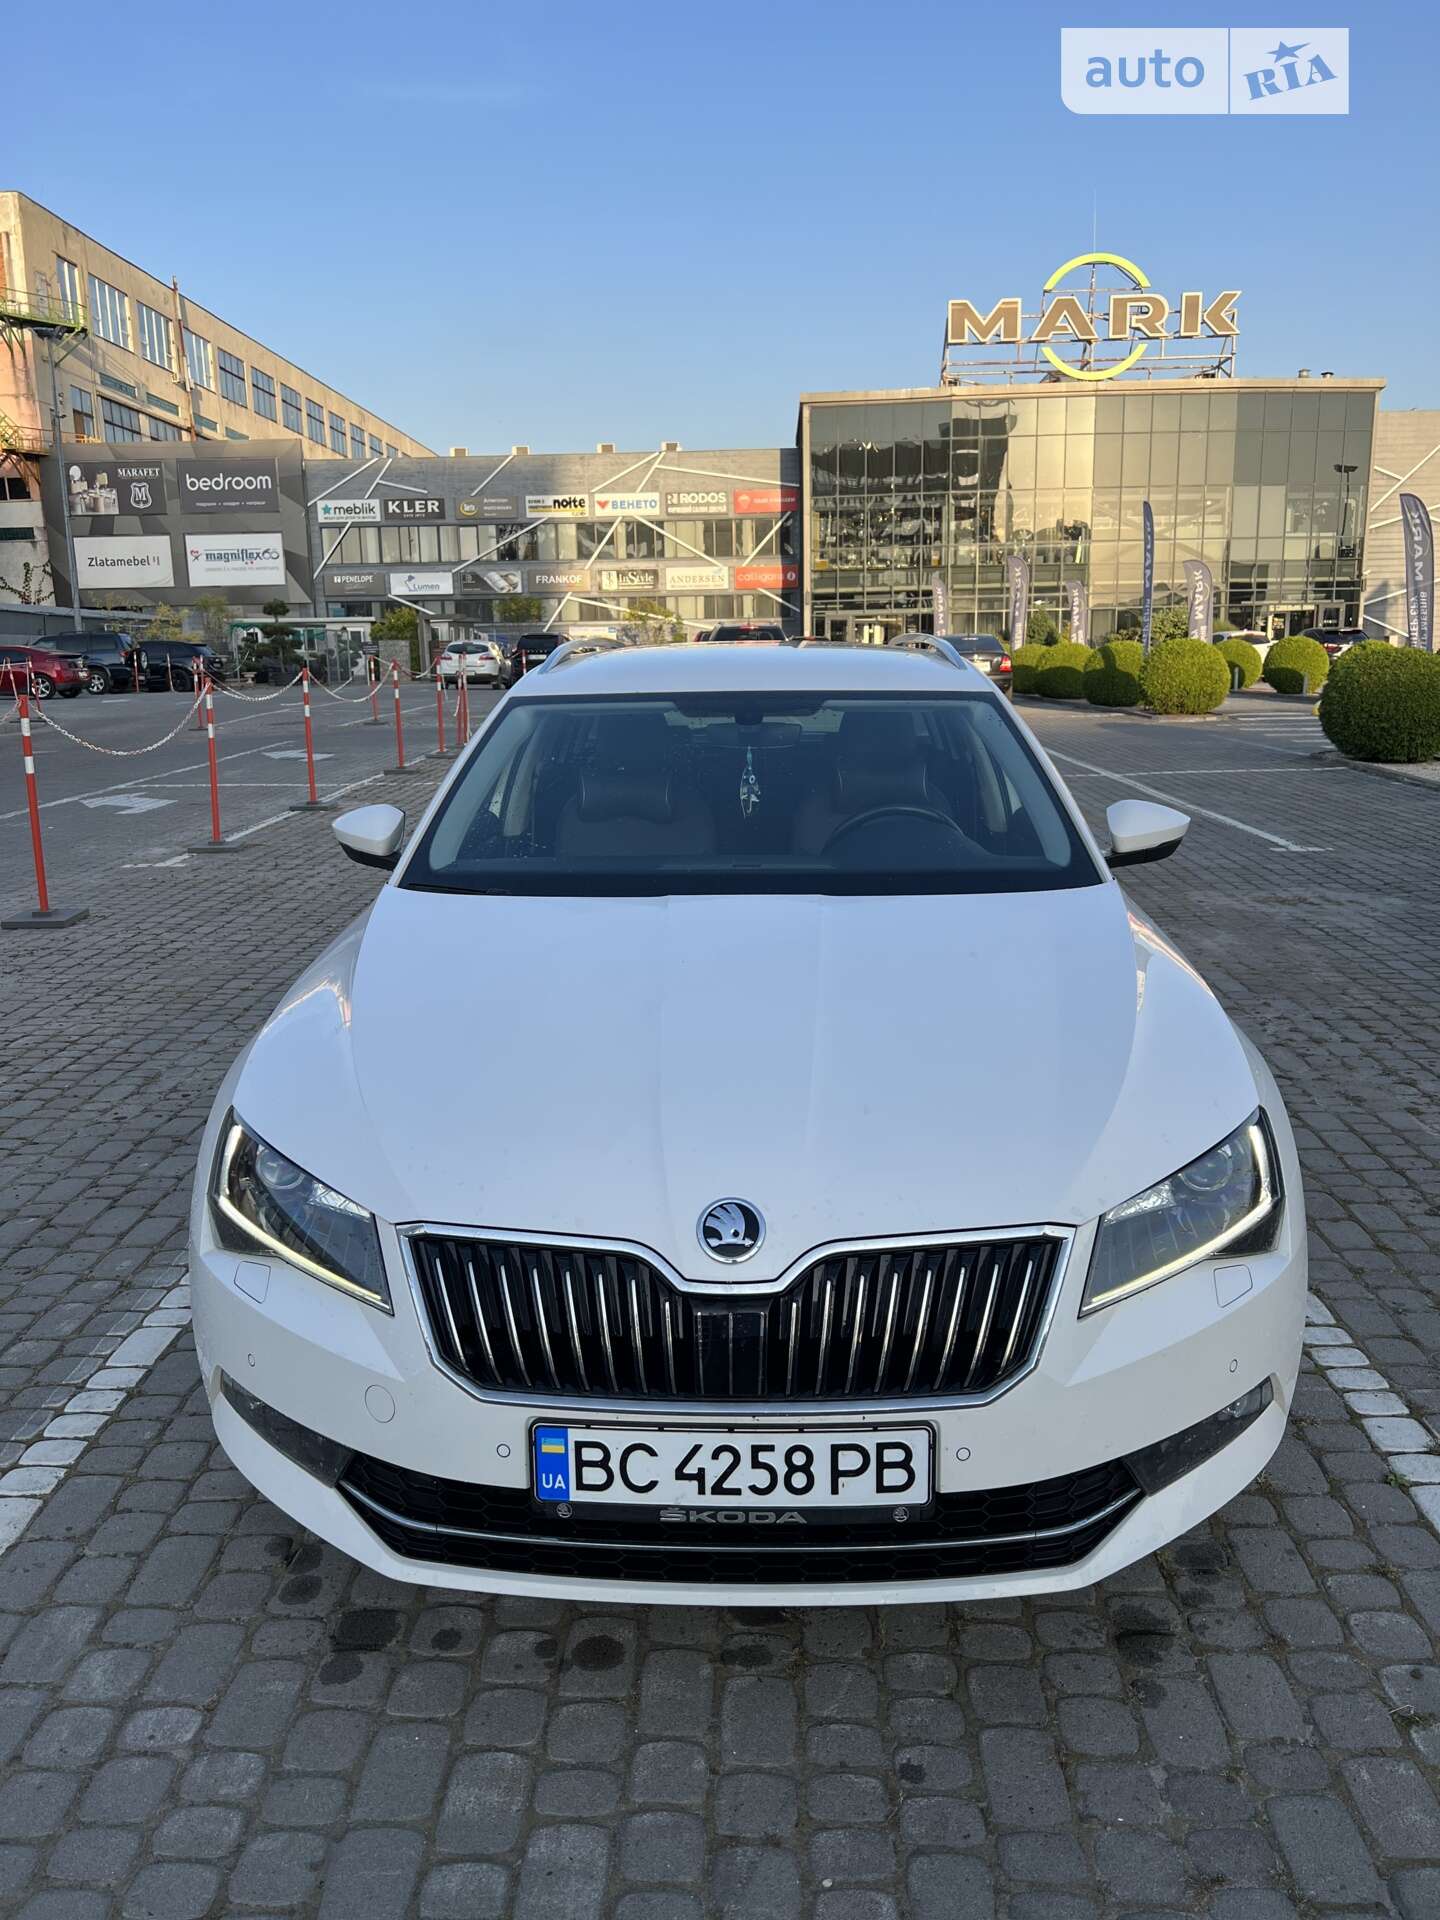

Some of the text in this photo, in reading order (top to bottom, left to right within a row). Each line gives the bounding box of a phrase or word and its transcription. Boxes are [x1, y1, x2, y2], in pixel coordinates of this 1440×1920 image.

[947, 290, 1242, 344] MARK
[117, 467, 160, 477] MARAFET
[186, 472, 272, 491] bedroom
[679, 492, 727, 504] RODOS
[333, 502, 376, 515] meblik
[387, 500, 440, 513] KLER
[87, 554, 151, 567] Zlatamebel
[341, 575, 374, 583] PENELOPE
[671, 575, 725, 585] ANDERSEN
[413, 582, 440, 592] Lumen
[574, 1440, 916, 1497] BC 4258 PB
[542, 1473, 566, 1489] UA
[658, 1506, 808, 1525] ŠKODA
